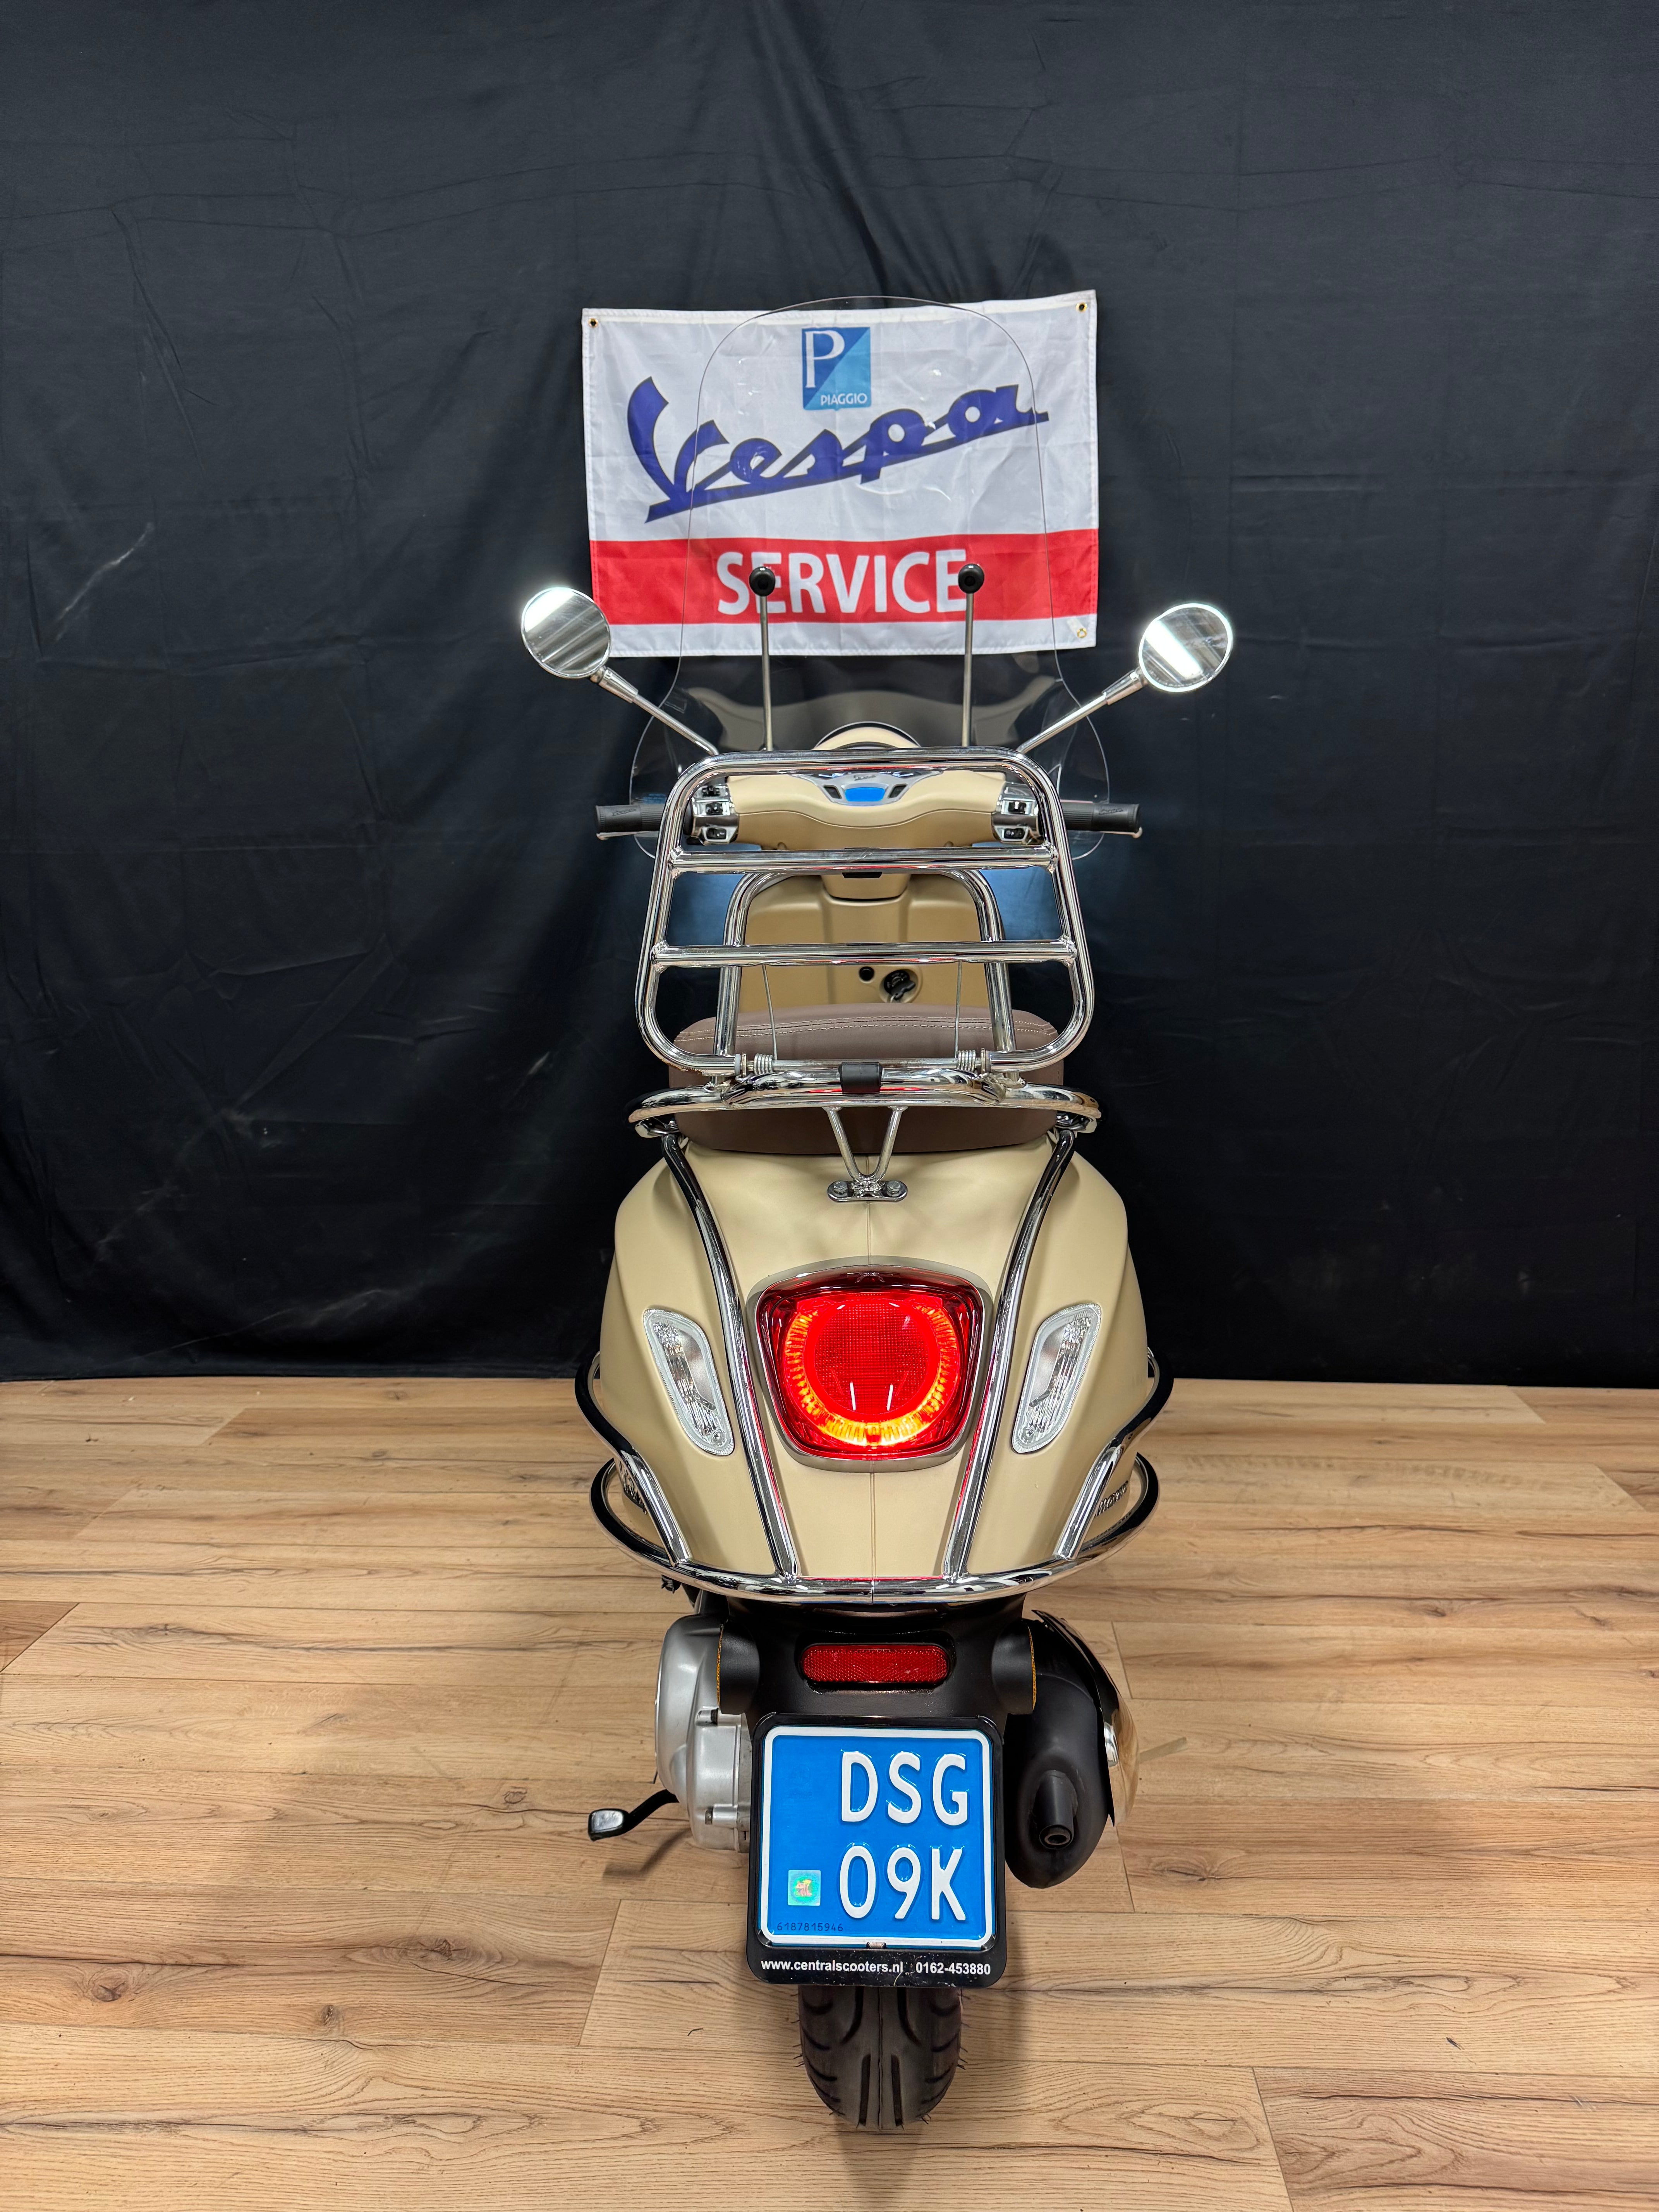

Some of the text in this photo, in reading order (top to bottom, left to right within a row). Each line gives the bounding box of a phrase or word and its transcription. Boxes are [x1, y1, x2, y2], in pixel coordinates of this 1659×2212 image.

[805, 330, 845, 388] P
[820, 393, 868, 406] PIAGGIO
[627, 376, 1049, 524] Vespa
[716, 549, 967, 615] SERVICE
[841, 1750, 968, 1826] DSG
[839, 1845, 966, 1921] 09K
[777, 1922, 843, 1932] 6187815946
[761, 1960, 991, 1975] www.centralscooters.nl 0162-453880
